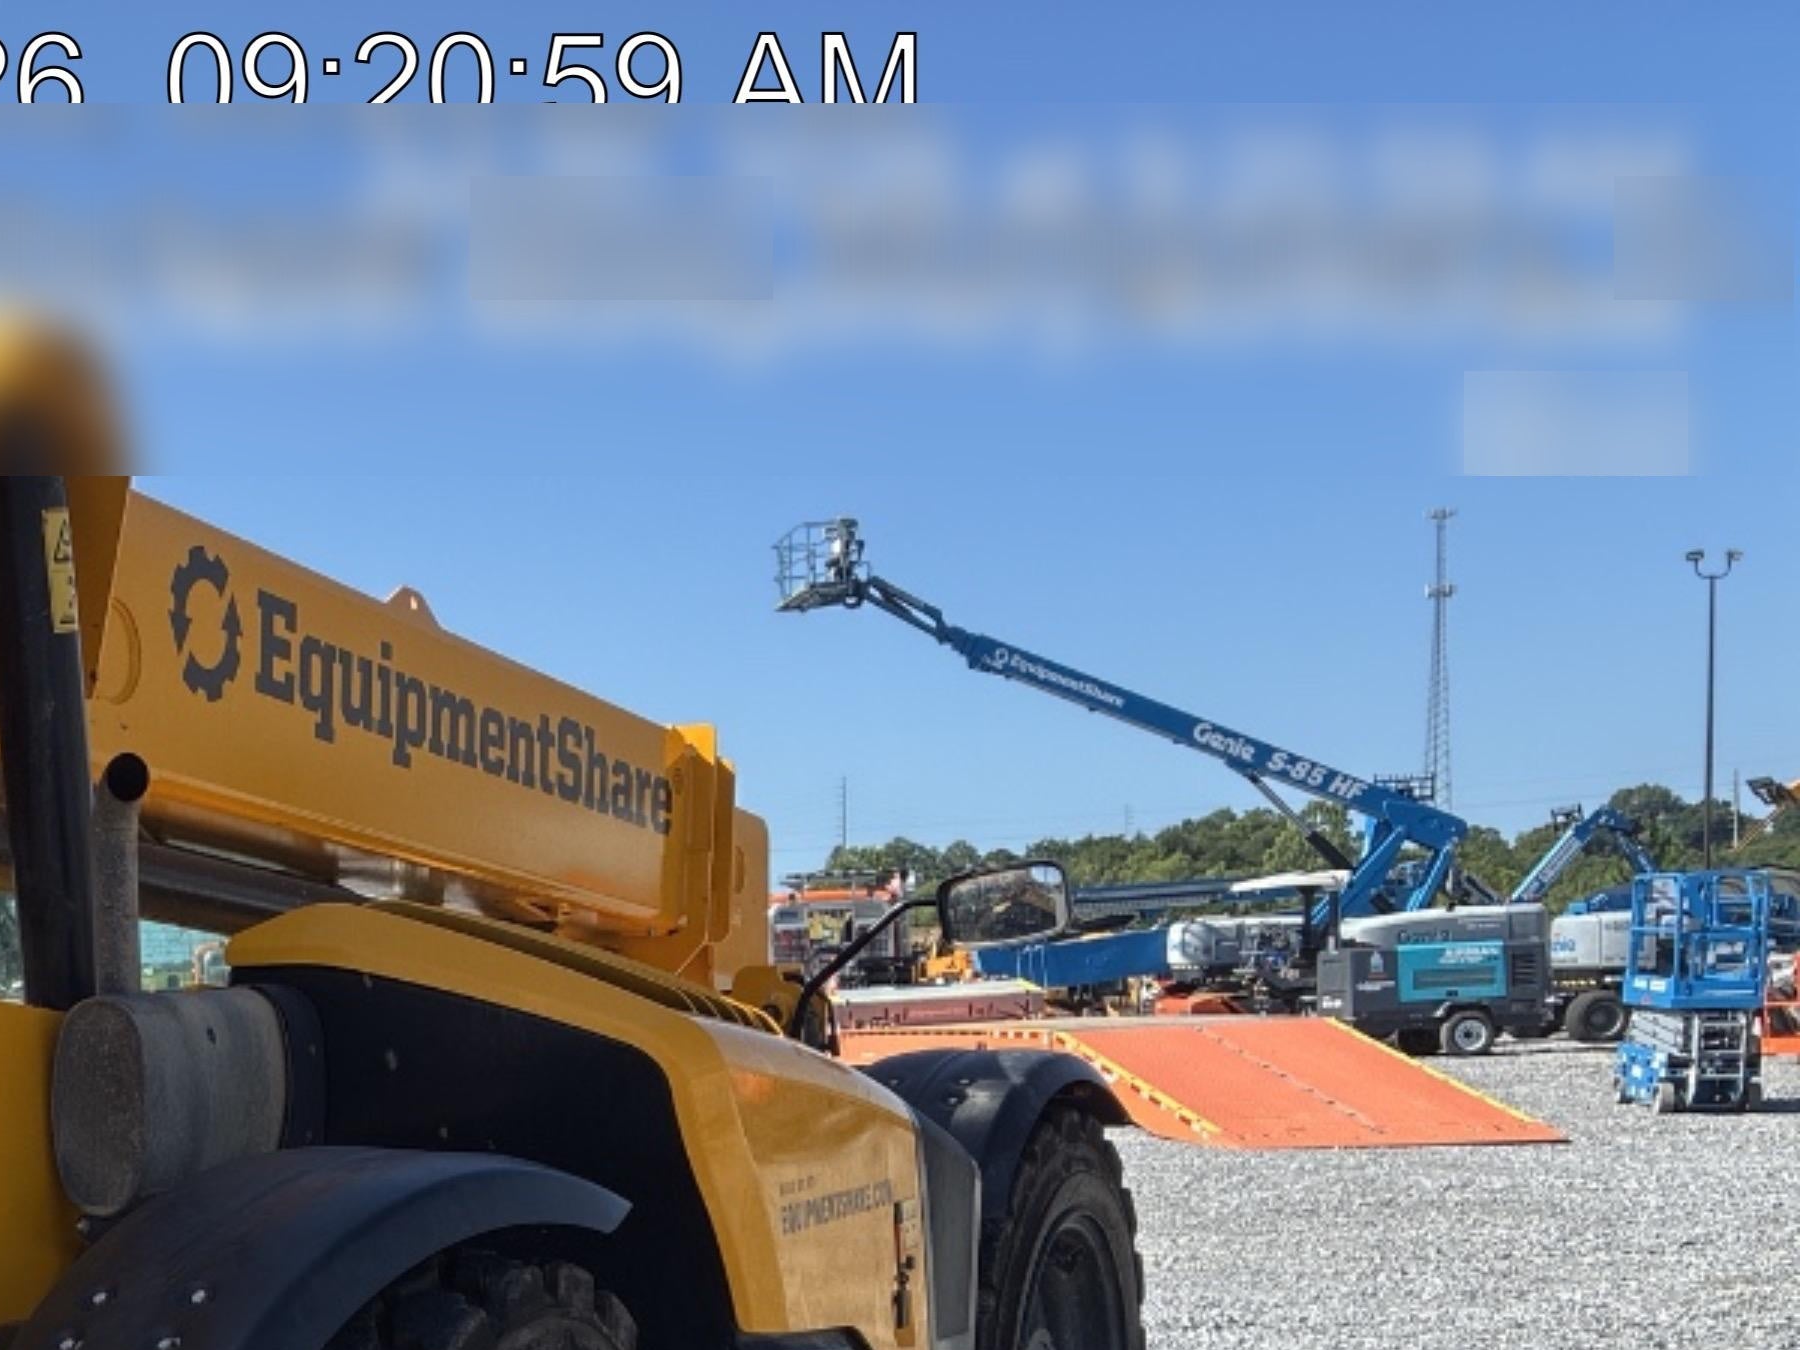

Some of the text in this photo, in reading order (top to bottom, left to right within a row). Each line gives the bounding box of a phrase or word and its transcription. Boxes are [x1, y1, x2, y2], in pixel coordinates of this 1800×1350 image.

[255, 588, 672, 836] EquipmentShare
[1193, 722, 1369, 799] Genie S-85 HF
